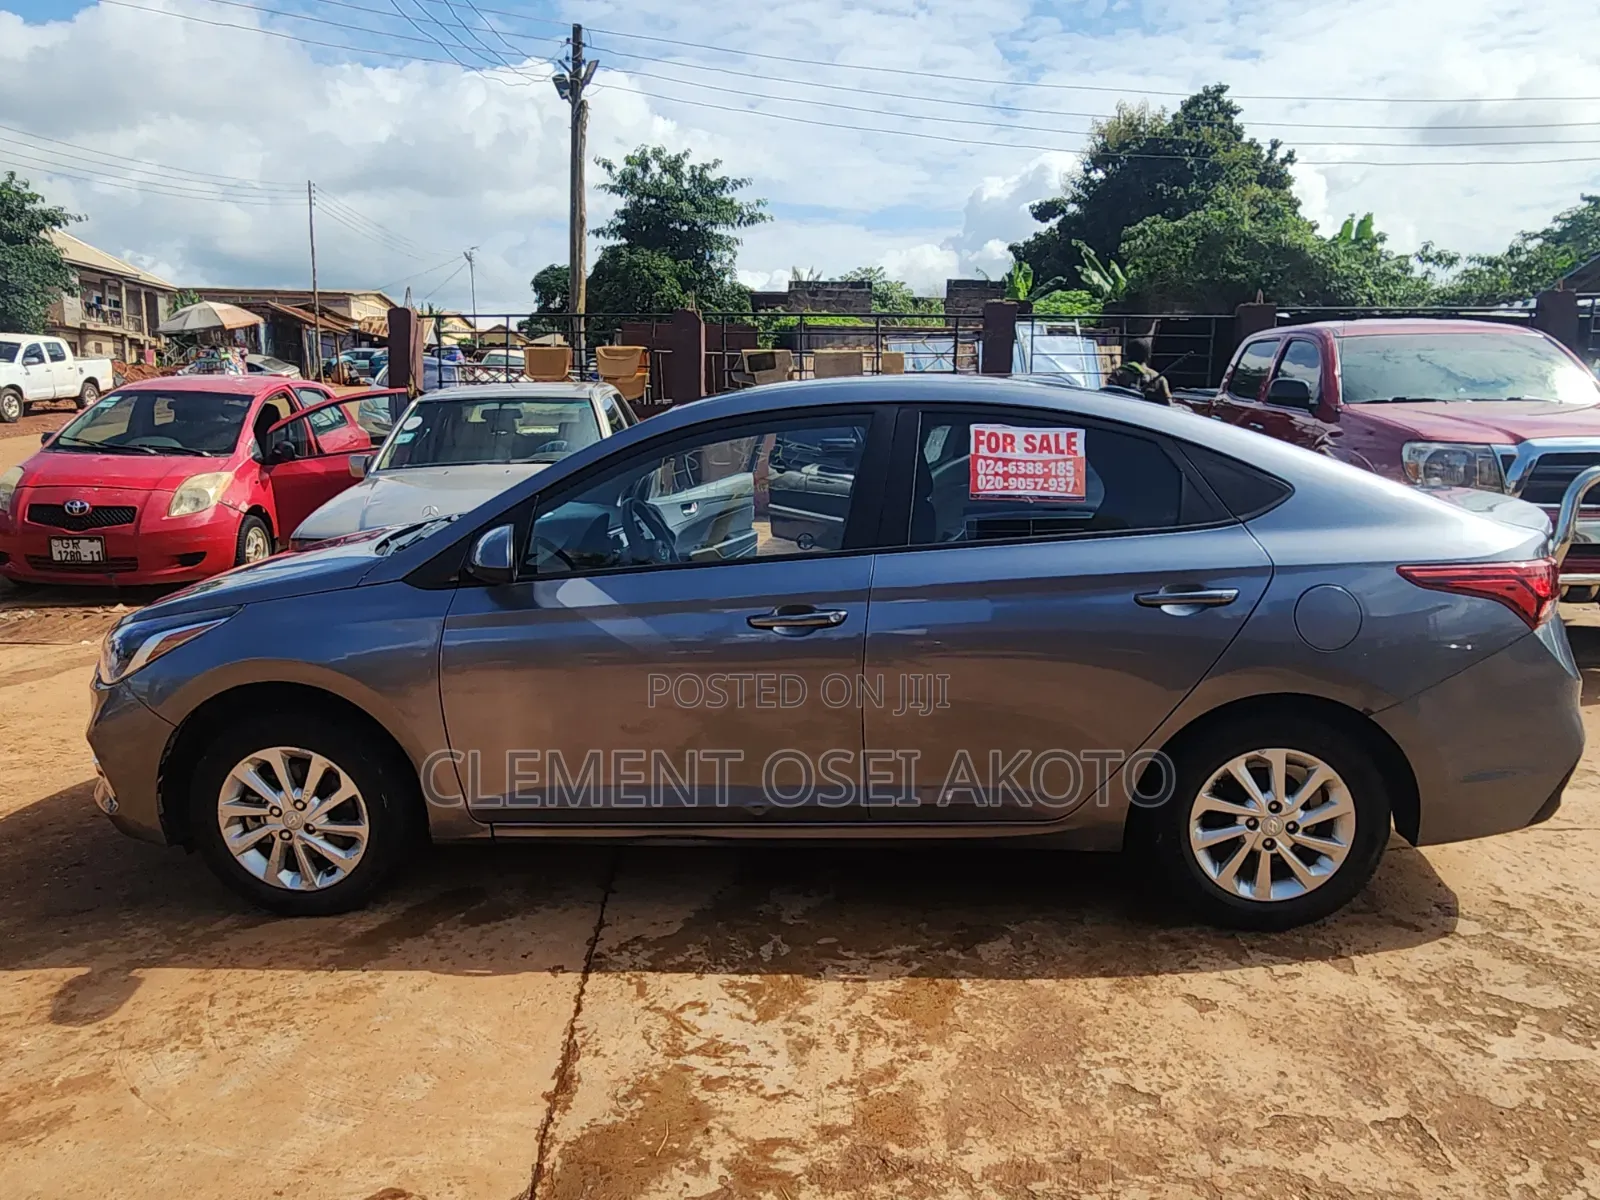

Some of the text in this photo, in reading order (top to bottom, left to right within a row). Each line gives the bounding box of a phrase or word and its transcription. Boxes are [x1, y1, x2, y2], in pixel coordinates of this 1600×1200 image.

[974, 429, 1078, 456] FOR SALE
[977, 459, 1075, 477] 024-6388-185
[977, 474, 1075, 492] 020-9057-937
[61, 539, 81, 549] GR
